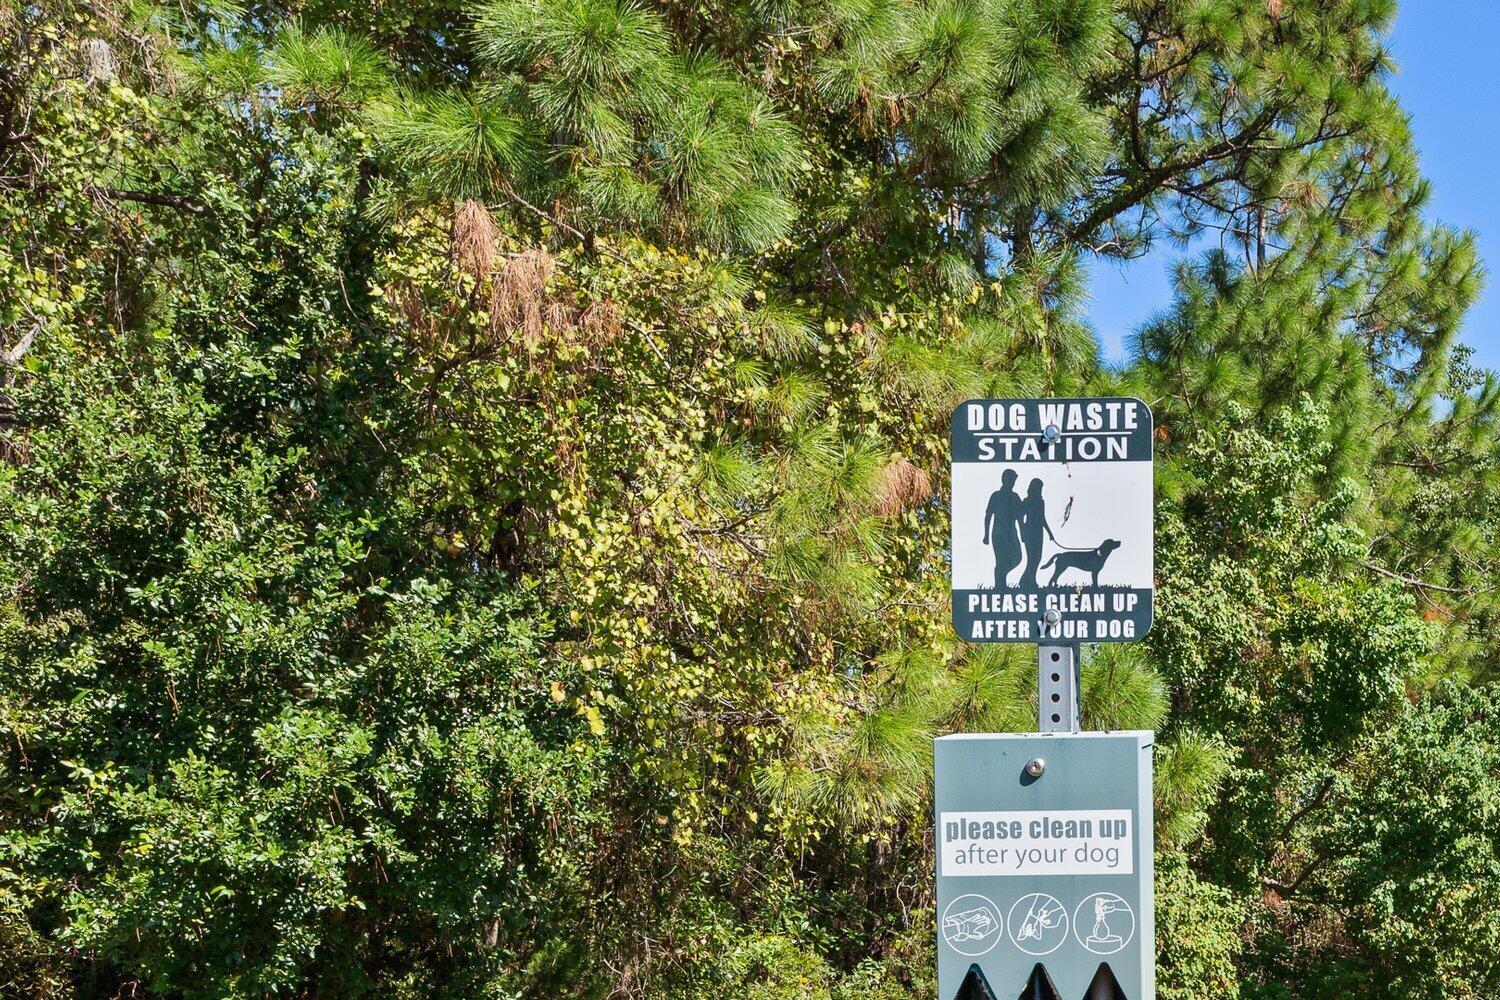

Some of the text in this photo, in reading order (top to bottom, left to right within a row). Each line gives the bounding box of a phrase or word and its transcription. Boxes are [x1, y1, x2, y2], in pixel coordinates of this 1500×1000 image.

[967, 402, 1138, 431] DOG WASTE
[977, 436, 1128, 460] STATION
[968, 593, 1138, 613] PLEASE CLEAN UP
[972, 619, 1135, 639] AFTER YOUR DOG
[946, 817, 1127, 842] please clean up
[955, 842, 1120, 869] after your dog
